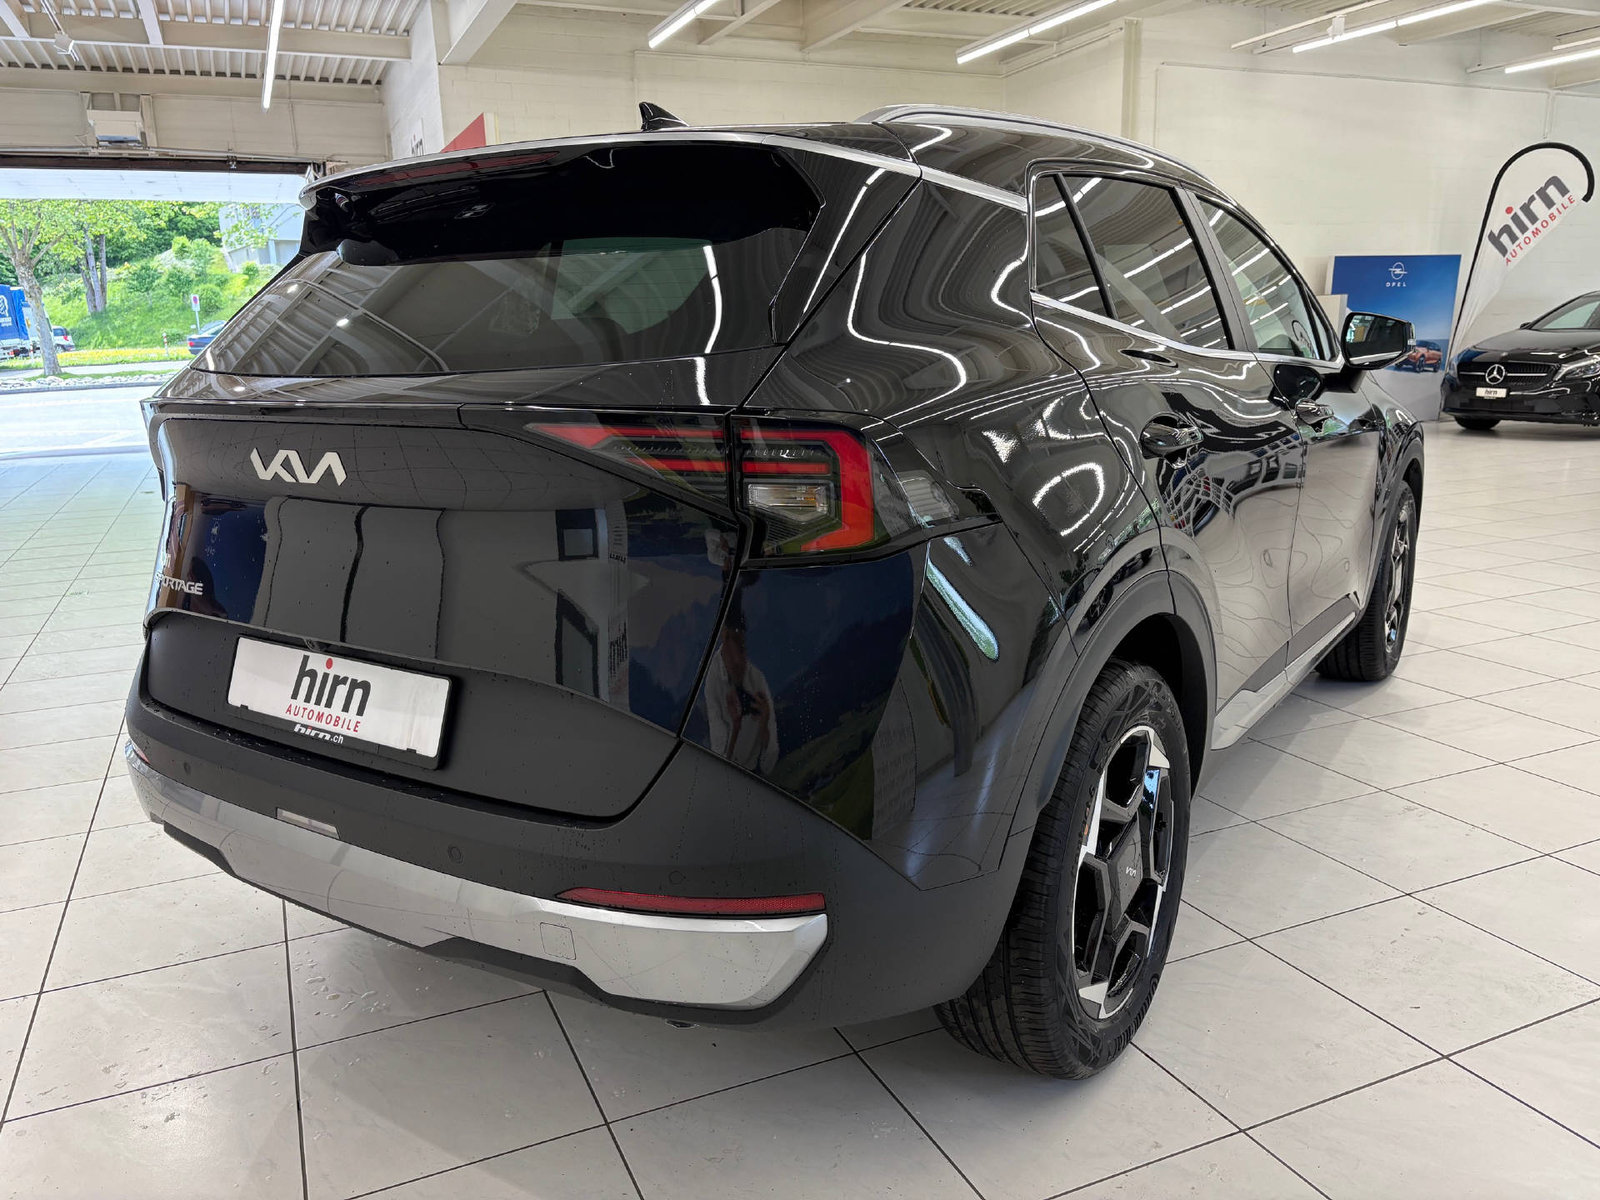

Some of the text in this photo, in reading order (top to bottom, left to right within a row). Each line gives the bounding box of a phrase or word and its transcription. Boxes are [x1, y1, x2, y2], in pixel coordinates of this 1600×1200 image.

[1487, 175, 1570, 258] hirn
[1505, 194, 1576, 267] AUTOMOBILE
[250, 447, 347, 486] KIA
[290, 654, 372, 717] hirn
[285, 703, 361, 733] AUTOMOBILE
[293, 723, 344, 744] hirn.ch
